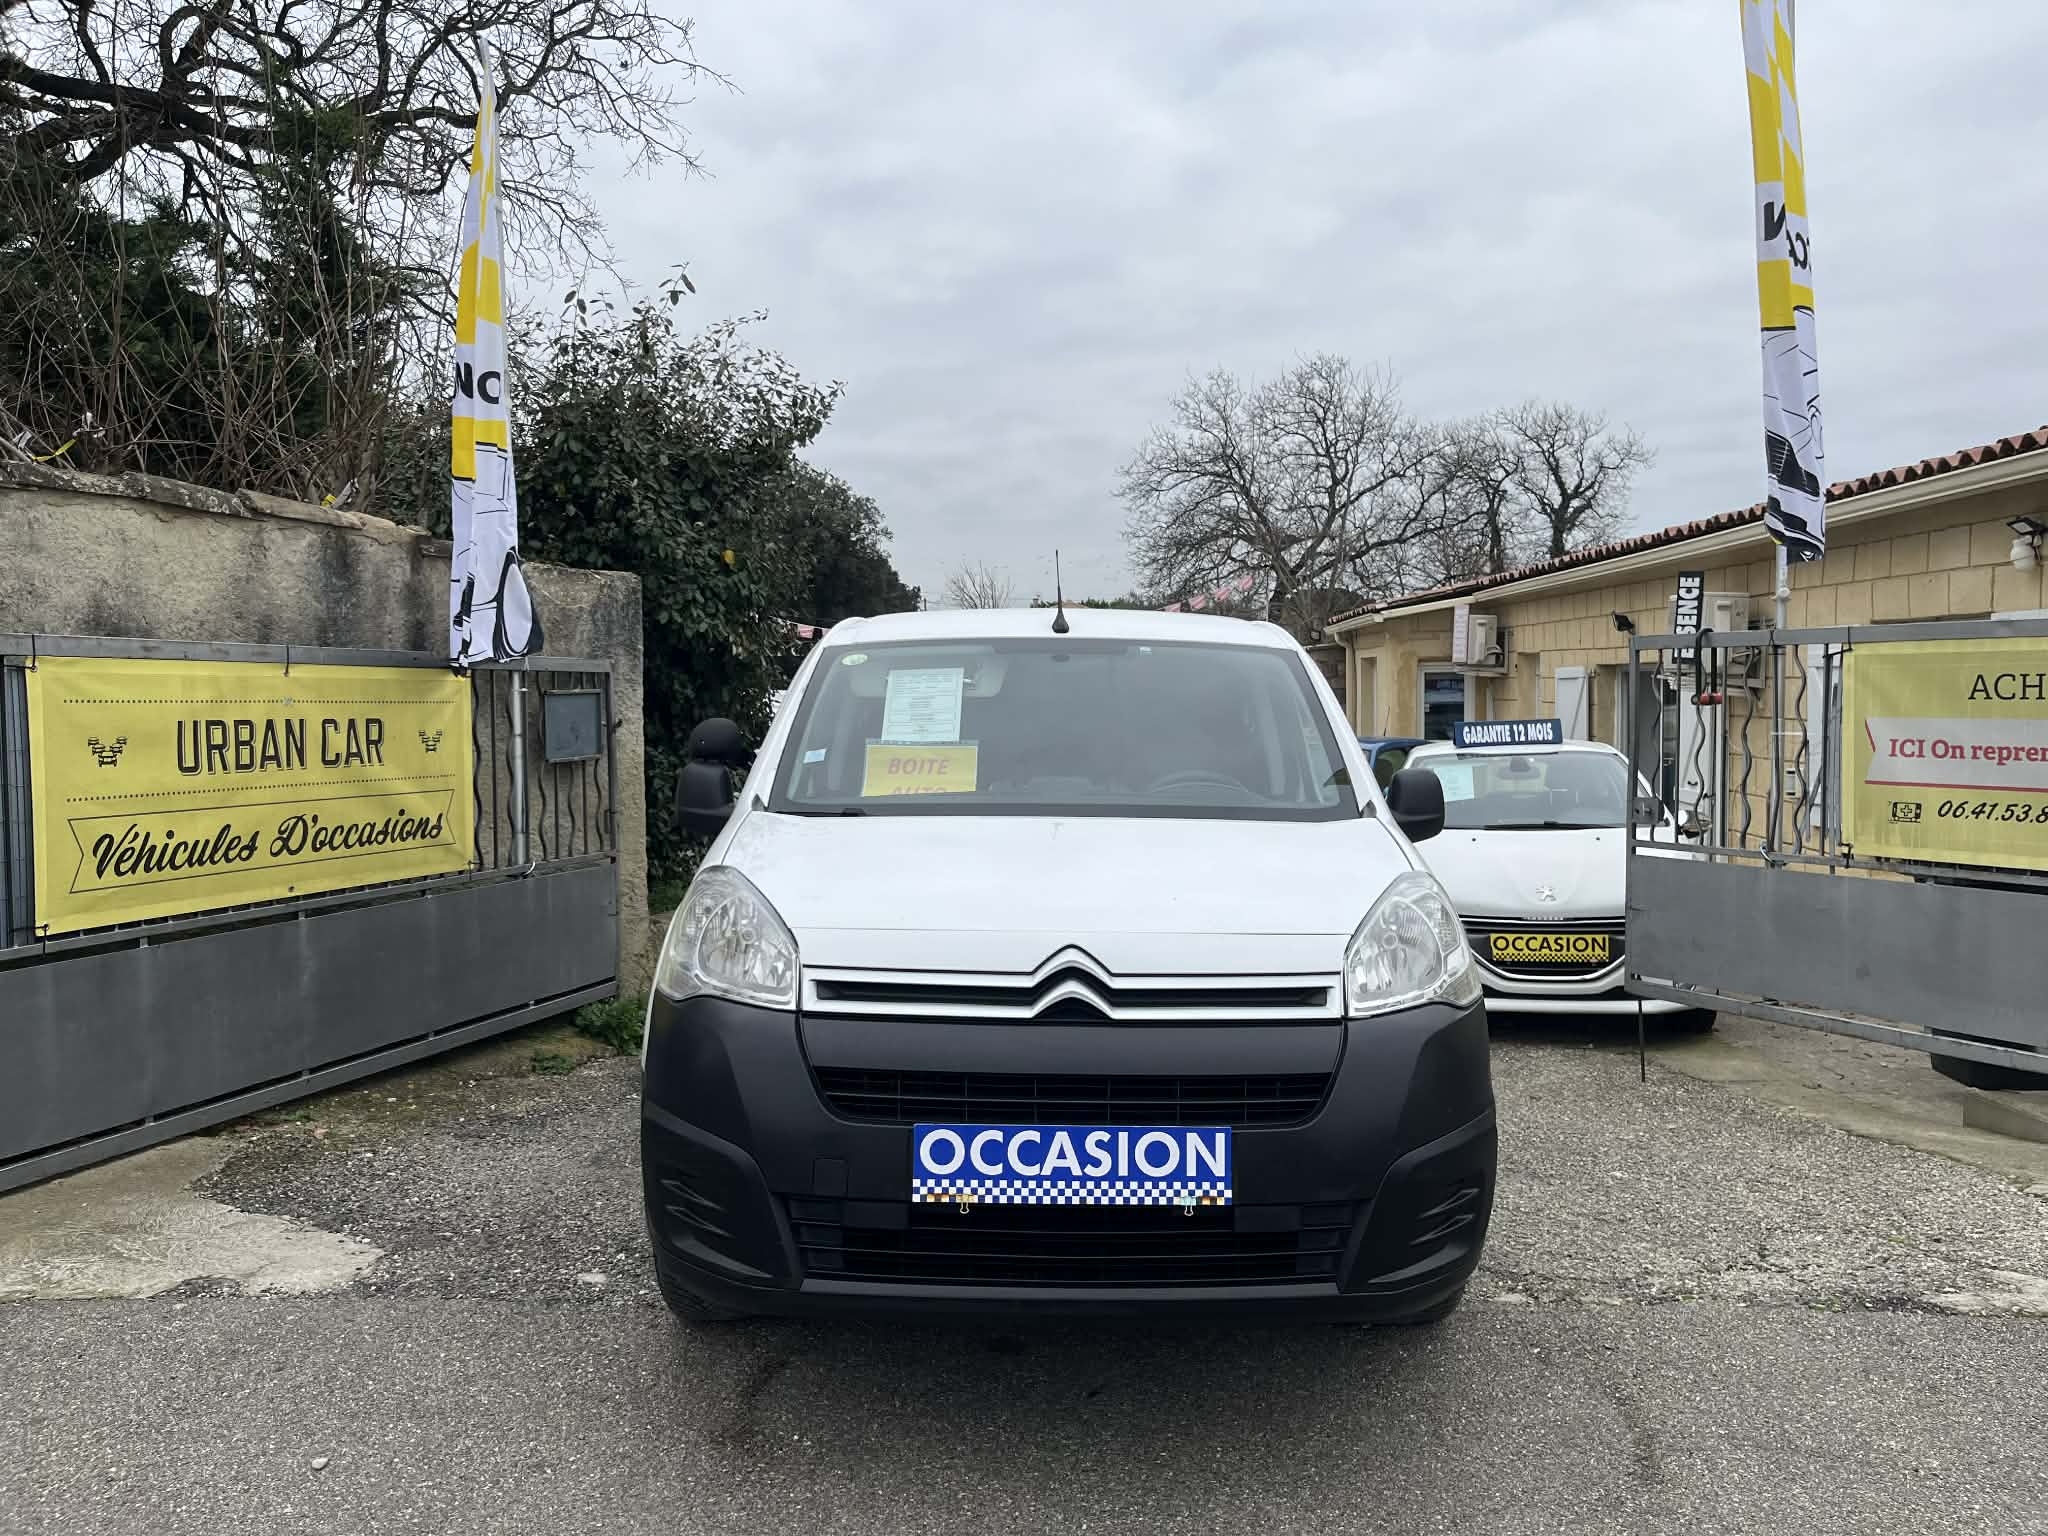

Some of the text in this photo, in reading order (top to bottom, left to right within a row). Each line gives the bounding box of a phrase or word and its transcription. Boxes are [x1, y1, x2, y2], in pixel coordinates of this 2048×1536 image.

[1674, 577, 1700, 659] ESENCE
[1968, 673, 2046, 700] ACH
[176, 718, 385, 776] URBAN CAR
[1463, 723, 1553, 744] GARANTIE 12 MOIS
[1888, 738, 1926, 758] ICI
[1931, 739, 1966, 760] On
[888, 758, 950, 775] BOITE
[92, 808, 444, 880] Véhicules D'occasions
[1493, 936, 1607, 952] OCCASION
[919, 1128, 1226, 1177] OCCASION
